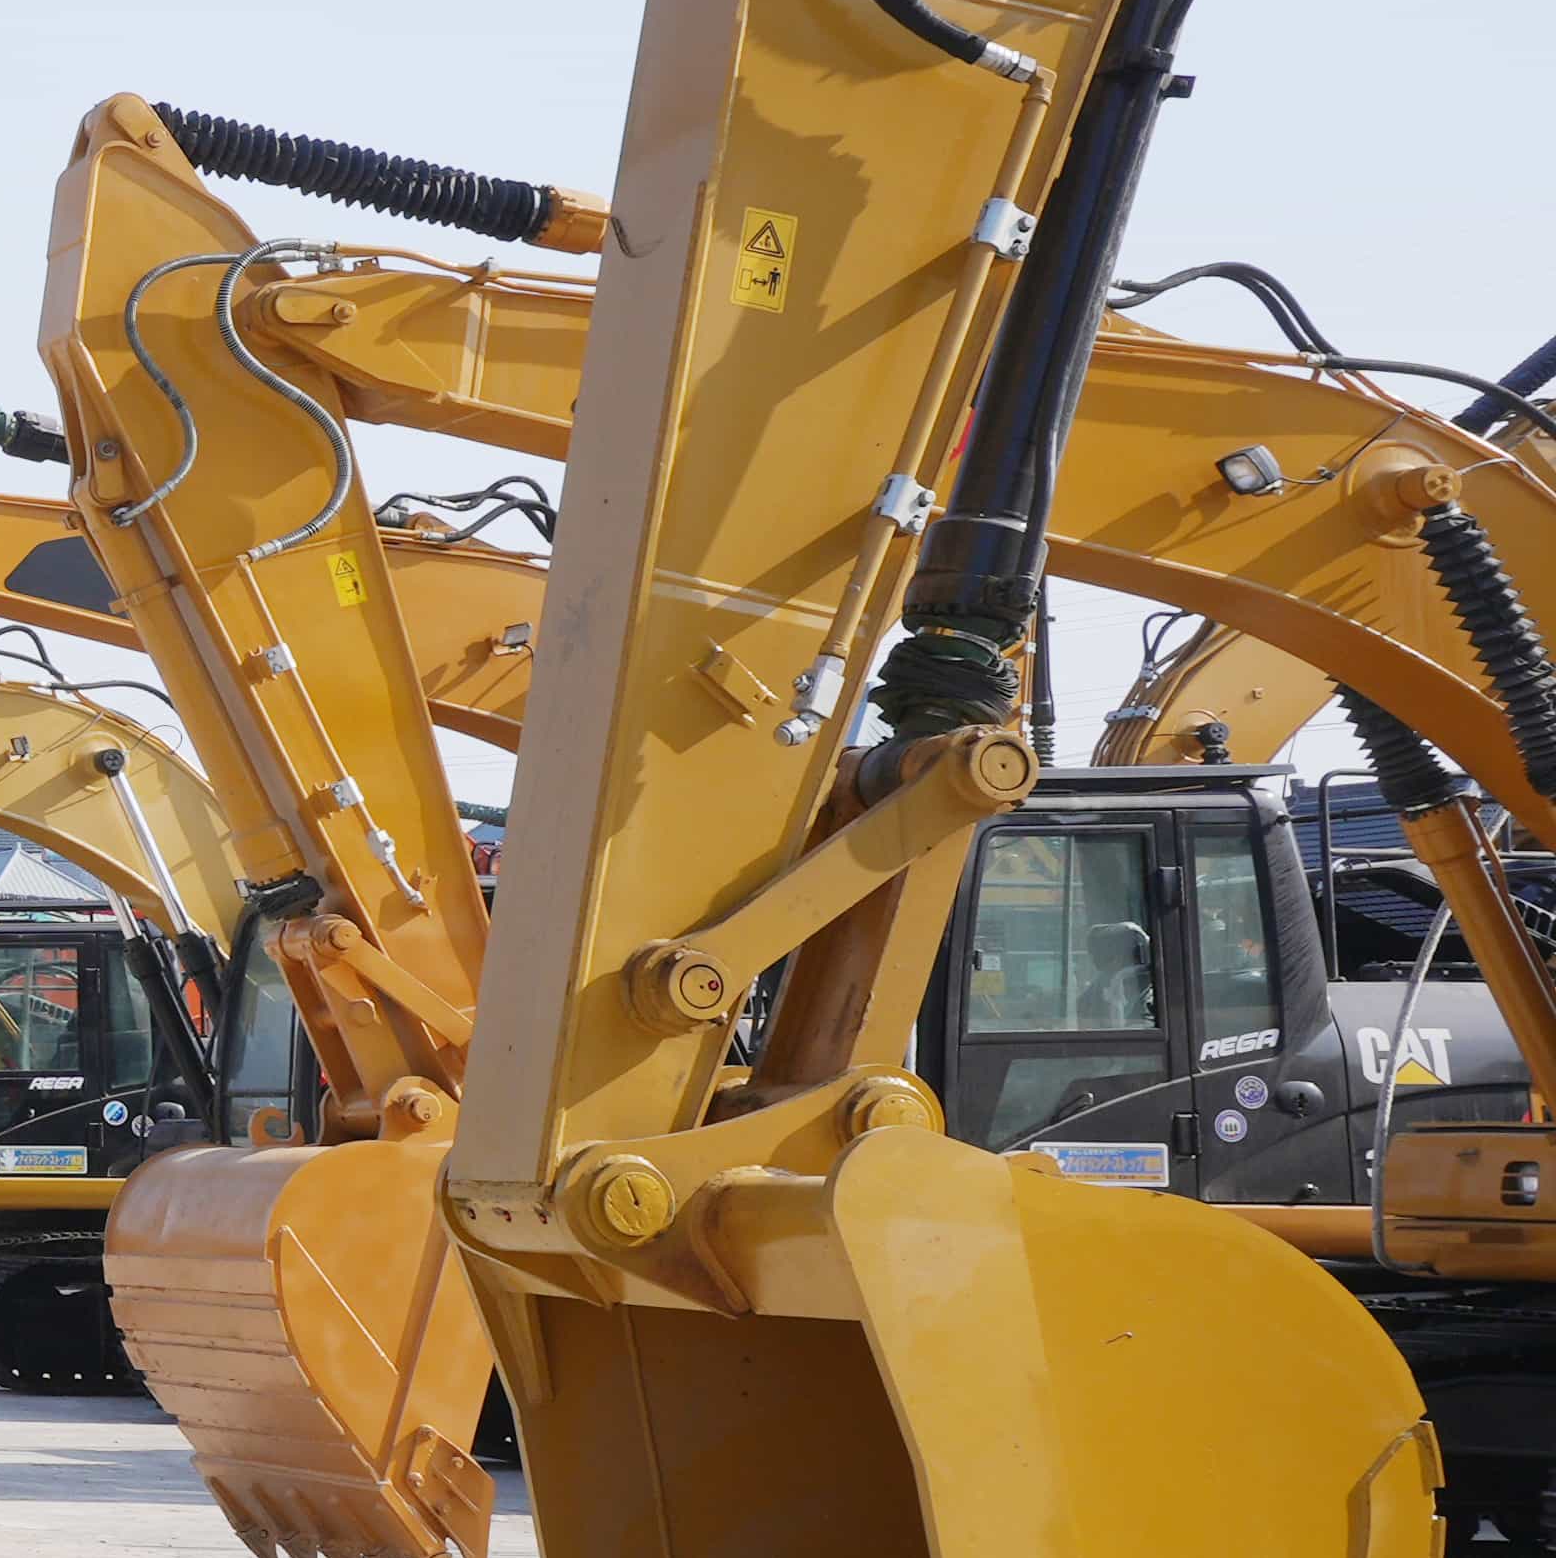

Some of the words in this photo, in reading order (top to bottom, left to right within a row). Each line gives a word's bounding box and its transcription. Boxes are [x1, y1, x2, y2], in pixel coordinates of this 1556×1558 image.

[1199, 1027, 1281, 1061] REGA
[1356, 1026, 1453, 1085] CAT
[28, 1076, 85, 1091] REGA
